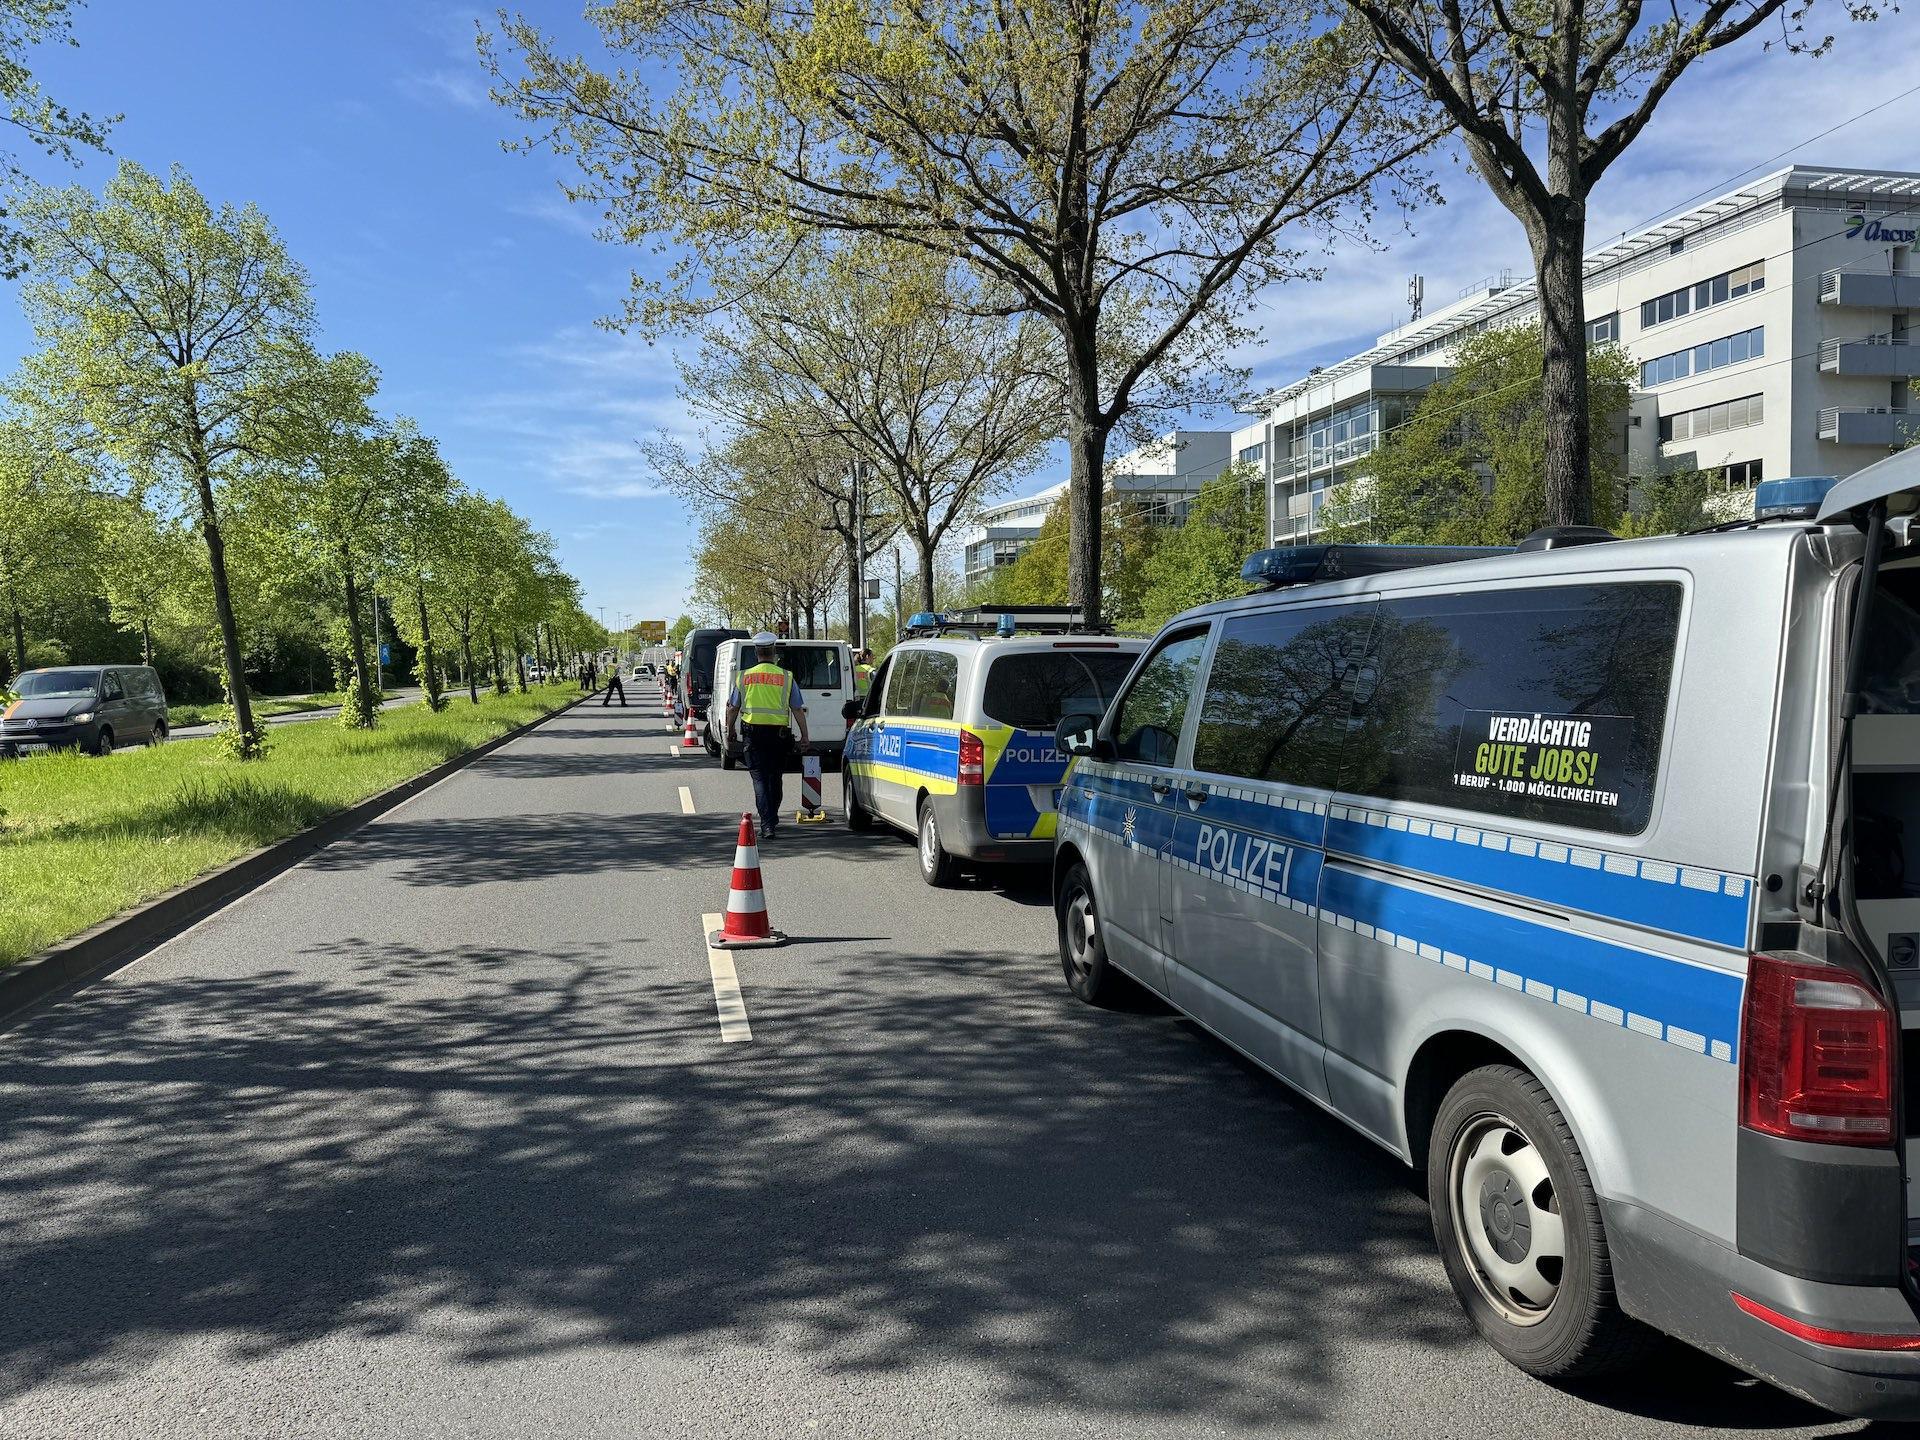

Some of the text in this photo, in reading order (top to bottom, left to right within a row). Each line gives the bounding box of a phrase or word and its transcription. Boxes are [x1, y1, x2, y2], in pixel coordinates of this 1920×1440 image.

[878, 734, 901, 757] POLIZEI
[1489, 714, 1592, 748] VERDÄCHTIG
[1475, 743, 1599, 786] GUTE JOBS!
[1453, 774, 1459, 785] 1
[1460, 774, 1490, 789] BERUF
[1498, 779, 1525, 794] 1.000
[1527, 781, 1619, 807] MÖGLICHKEITEN
[1196, 824, 1294, 894] POLIZEI
